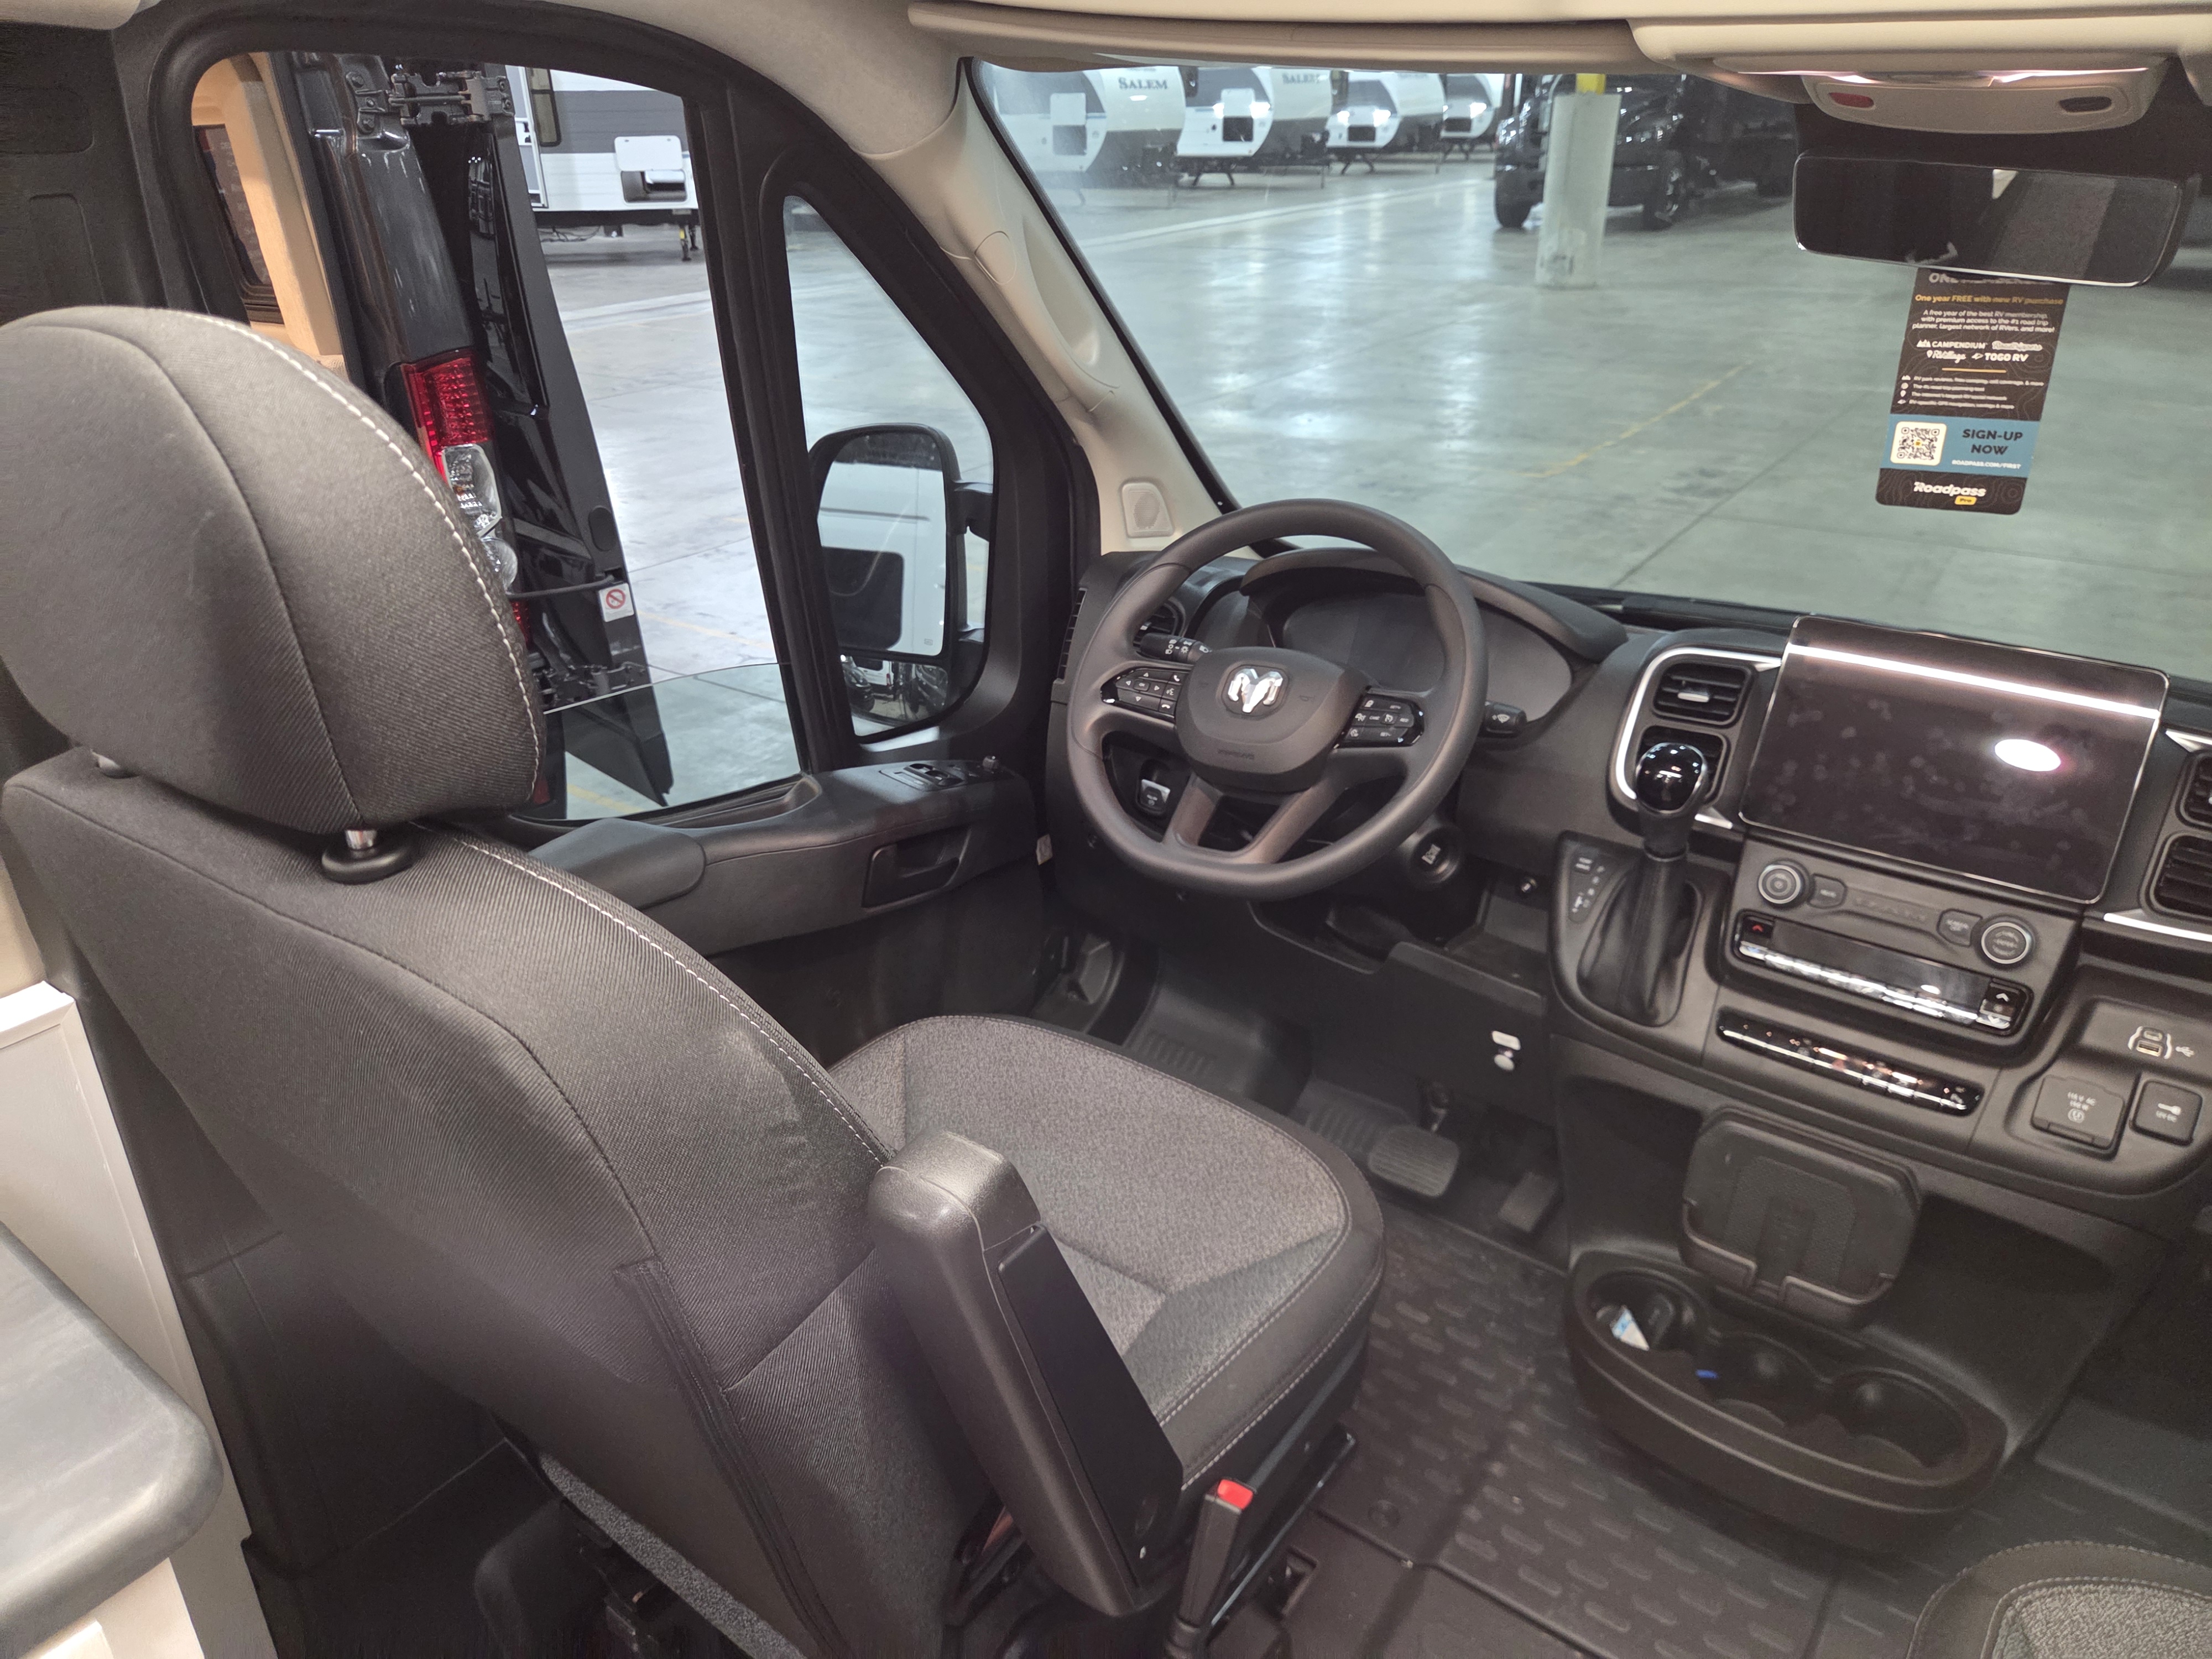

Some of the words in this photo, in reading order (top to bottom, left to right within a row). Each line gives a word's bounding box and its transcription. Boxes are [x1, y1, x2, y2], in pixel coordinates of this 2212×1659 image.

[1118, 77, 1168, 90] SALEM
[1984, 353, 2011, 361] TOGO
[1962, 429, 2023, 441] SIGN-UP
[1970, 444, 2009, 455] NOW
[1952, 460, 2022, 469] ROADPASS.COM/FIRST
[1913, 482, 1987, 497] Roadpass
